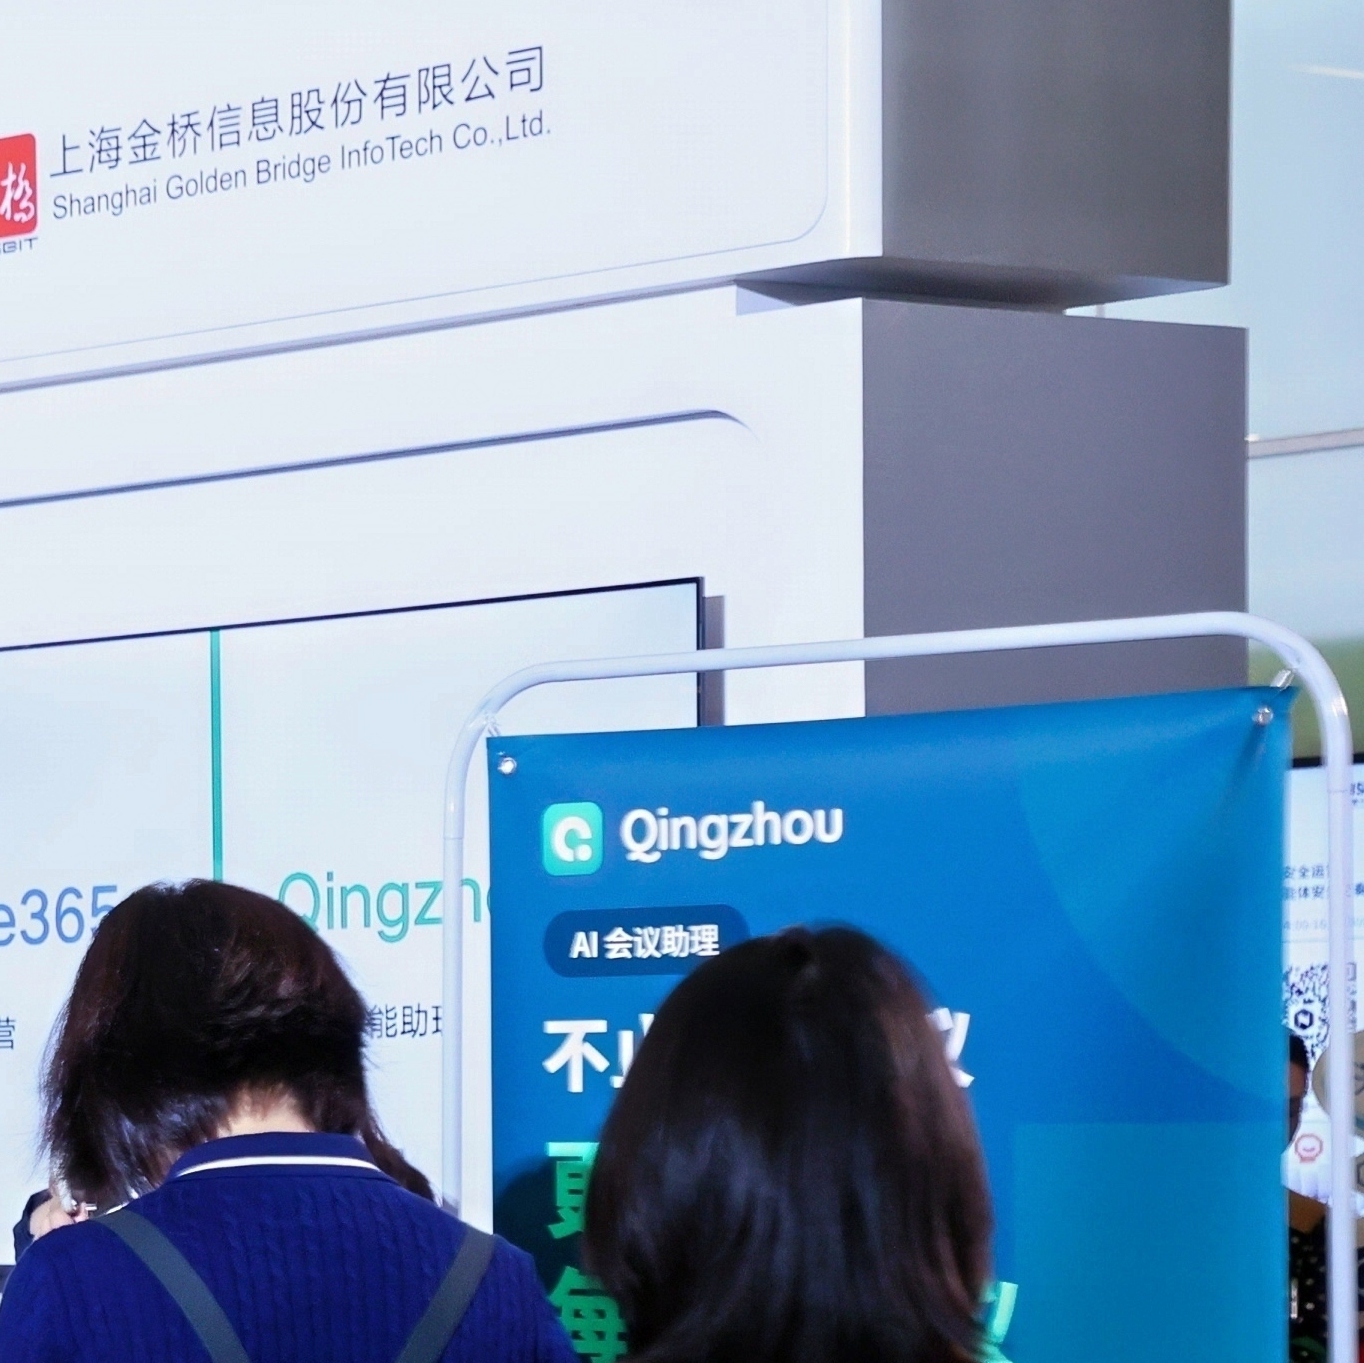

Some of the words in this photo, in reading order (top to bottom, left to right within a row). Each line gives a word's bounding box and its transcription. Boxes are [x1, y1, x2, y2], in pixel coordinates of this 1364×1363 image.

[49, 45, 547, 179] 上海金桥信息股份有限公司
[52, 178, 157, 220] Shanghai
[166, 166, 247, 202] Golden
[255, 148, 334, 190] Bridge
[339, 129, 445, 175] InfoTech
[450, 106, 552, 162] Co.,Ltd.
[619, 800, 845, 863] Qingzhou
[570, 931, 599, 960] AI
[602, 924, 720, 960] 会议助理
